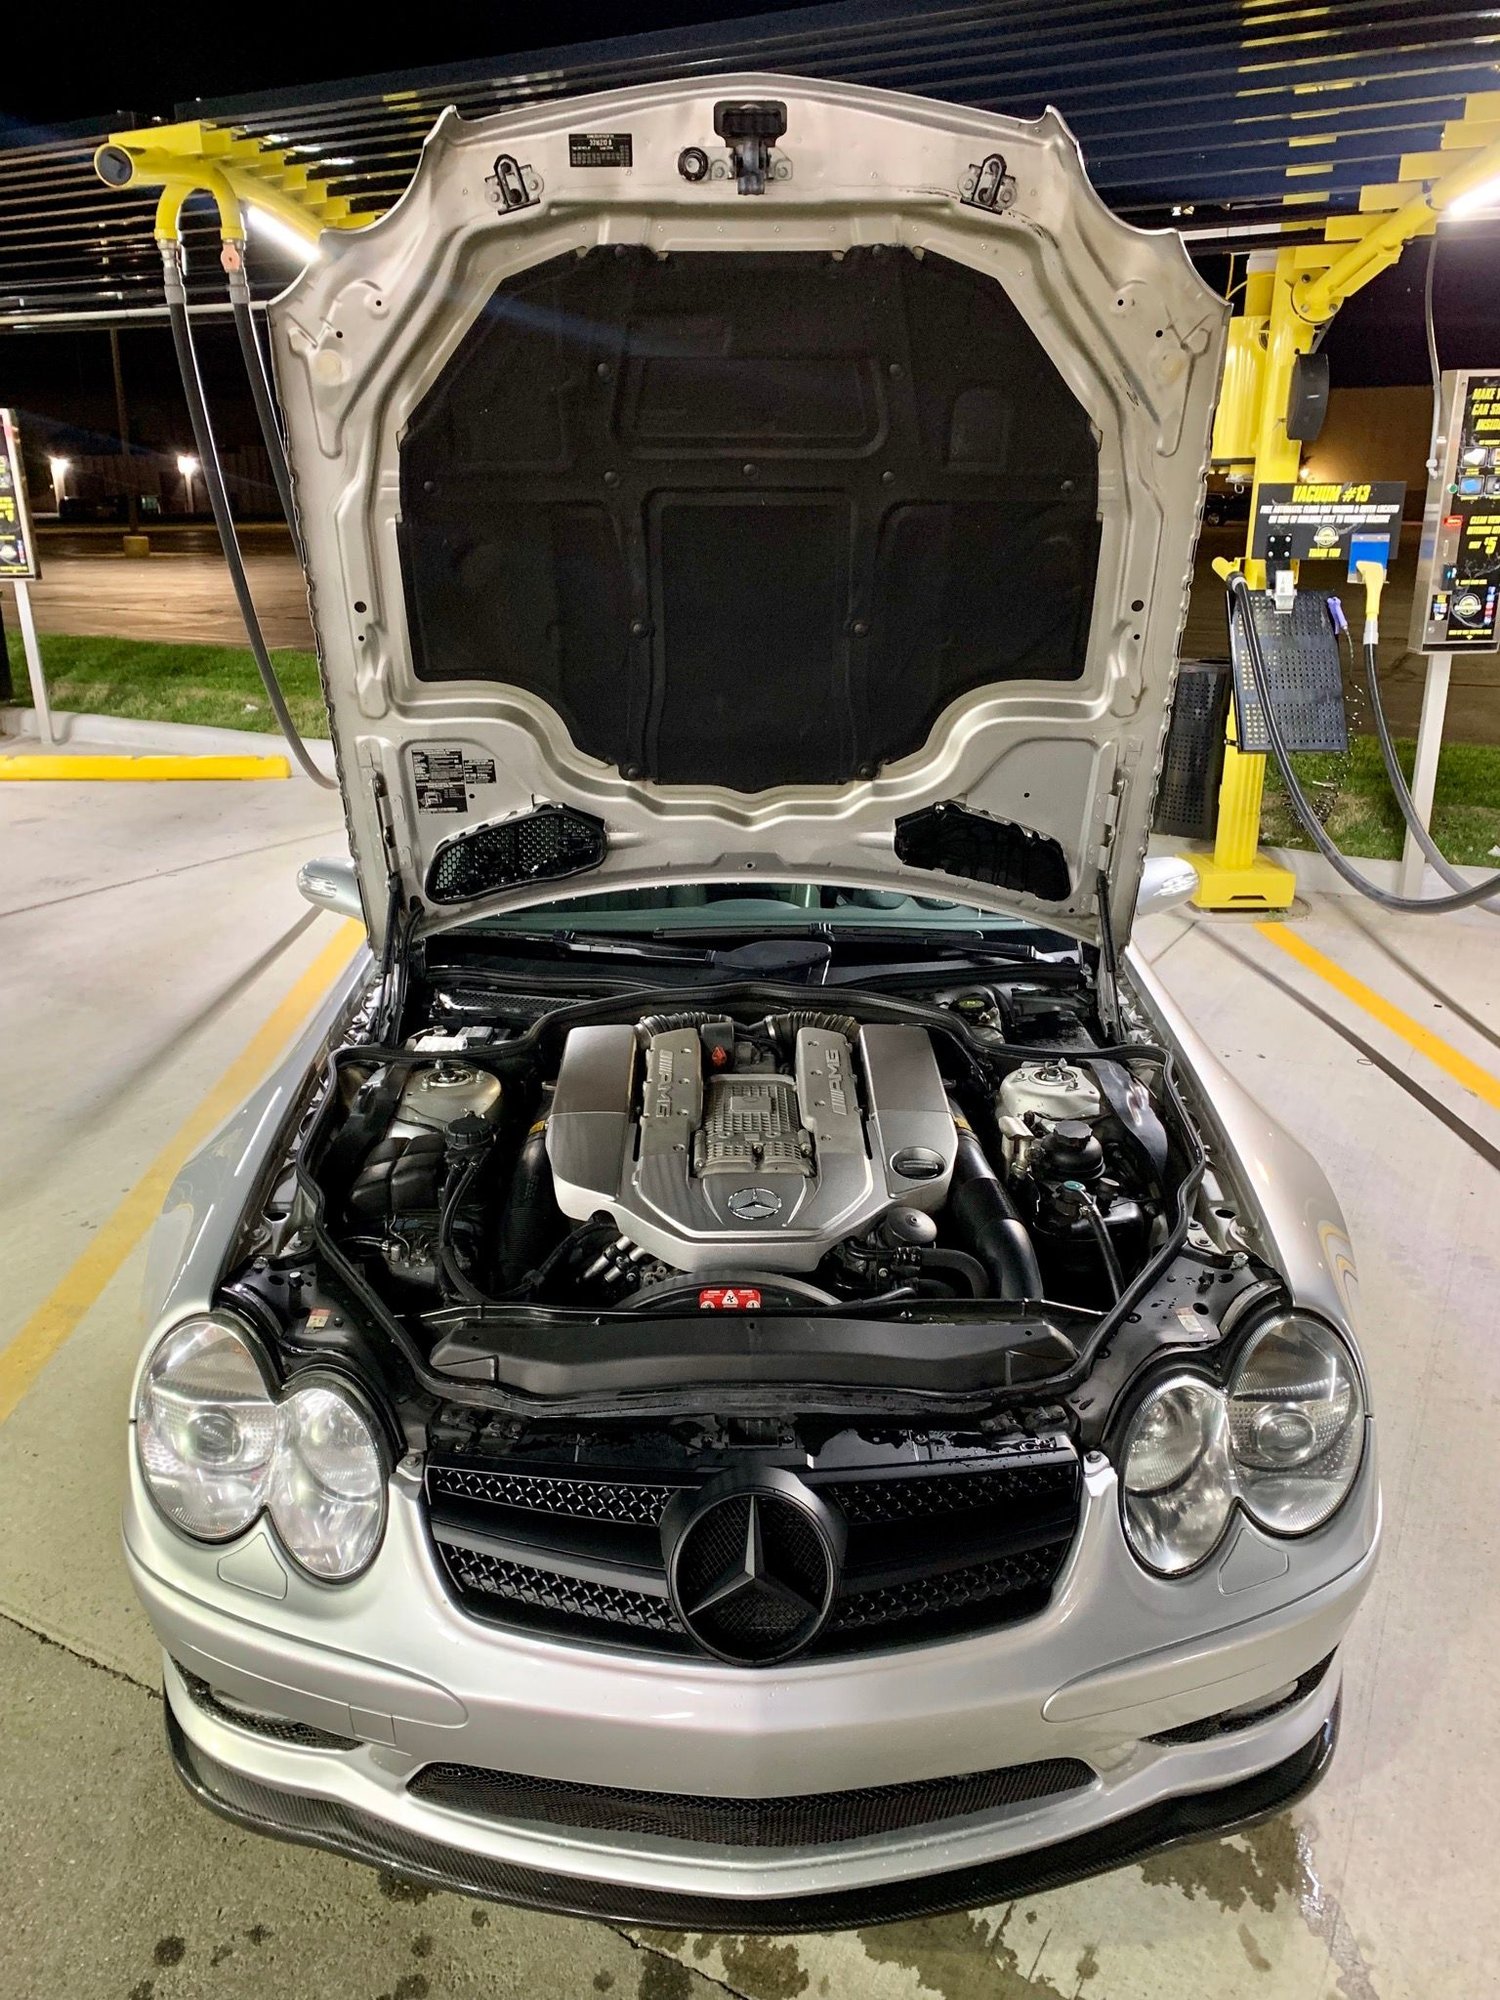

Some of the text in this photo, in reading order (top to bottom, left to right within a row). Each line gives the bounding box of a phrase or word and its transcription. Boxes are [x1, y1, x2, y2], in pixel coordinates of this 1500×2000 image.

[1472, 388, 1497, 400] MAKE
[1471, 403, 1490, 415] CAR
[1475, 418, 1500, 431] INSID
[1292, 485, 1372, 502] VACUUM #13
[825, 1049, 844, 1093] AMG
